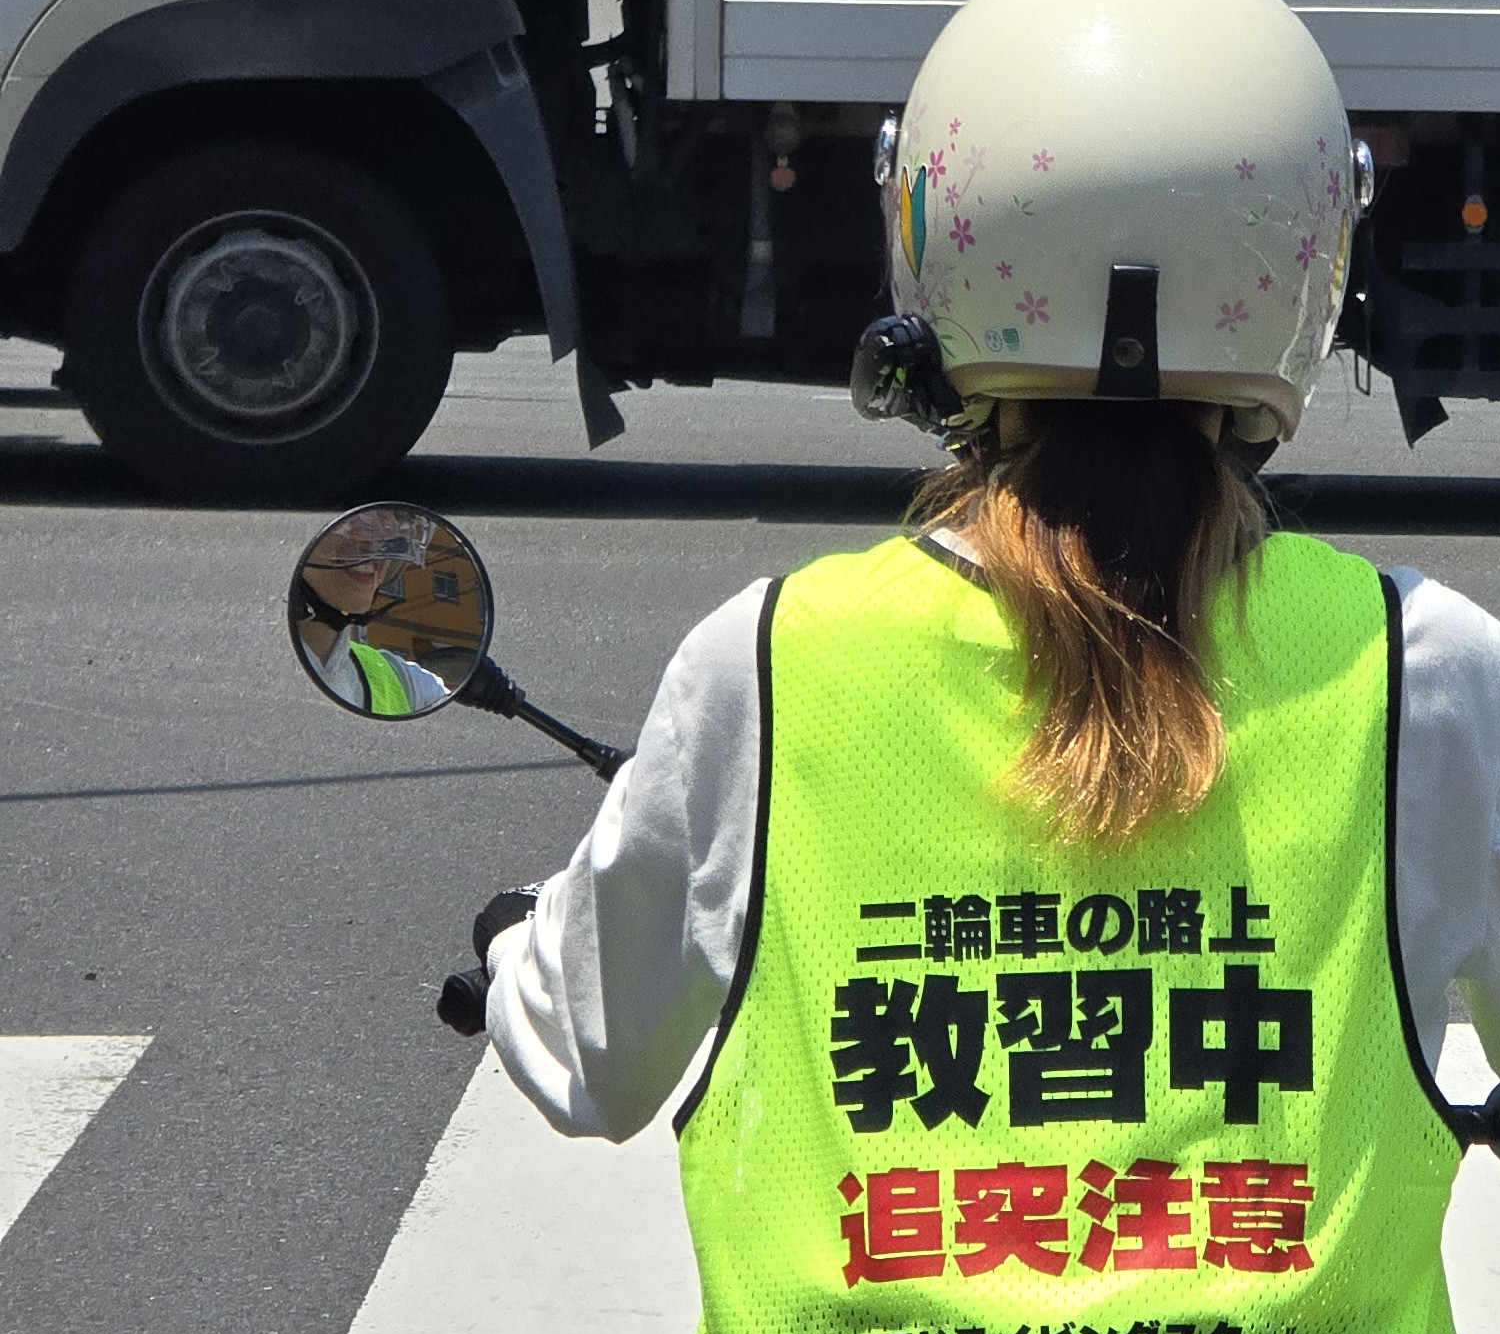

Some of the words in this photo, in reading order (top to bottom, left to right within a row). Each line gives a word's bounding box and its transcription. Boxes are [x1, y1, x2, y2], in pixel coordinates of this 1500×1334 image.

[856, 886, 1276, 962] 二輪車の路上
[829, 964, 1314, 1134] 教習中
[837, 1157, 1315, 1290] 追突注意
